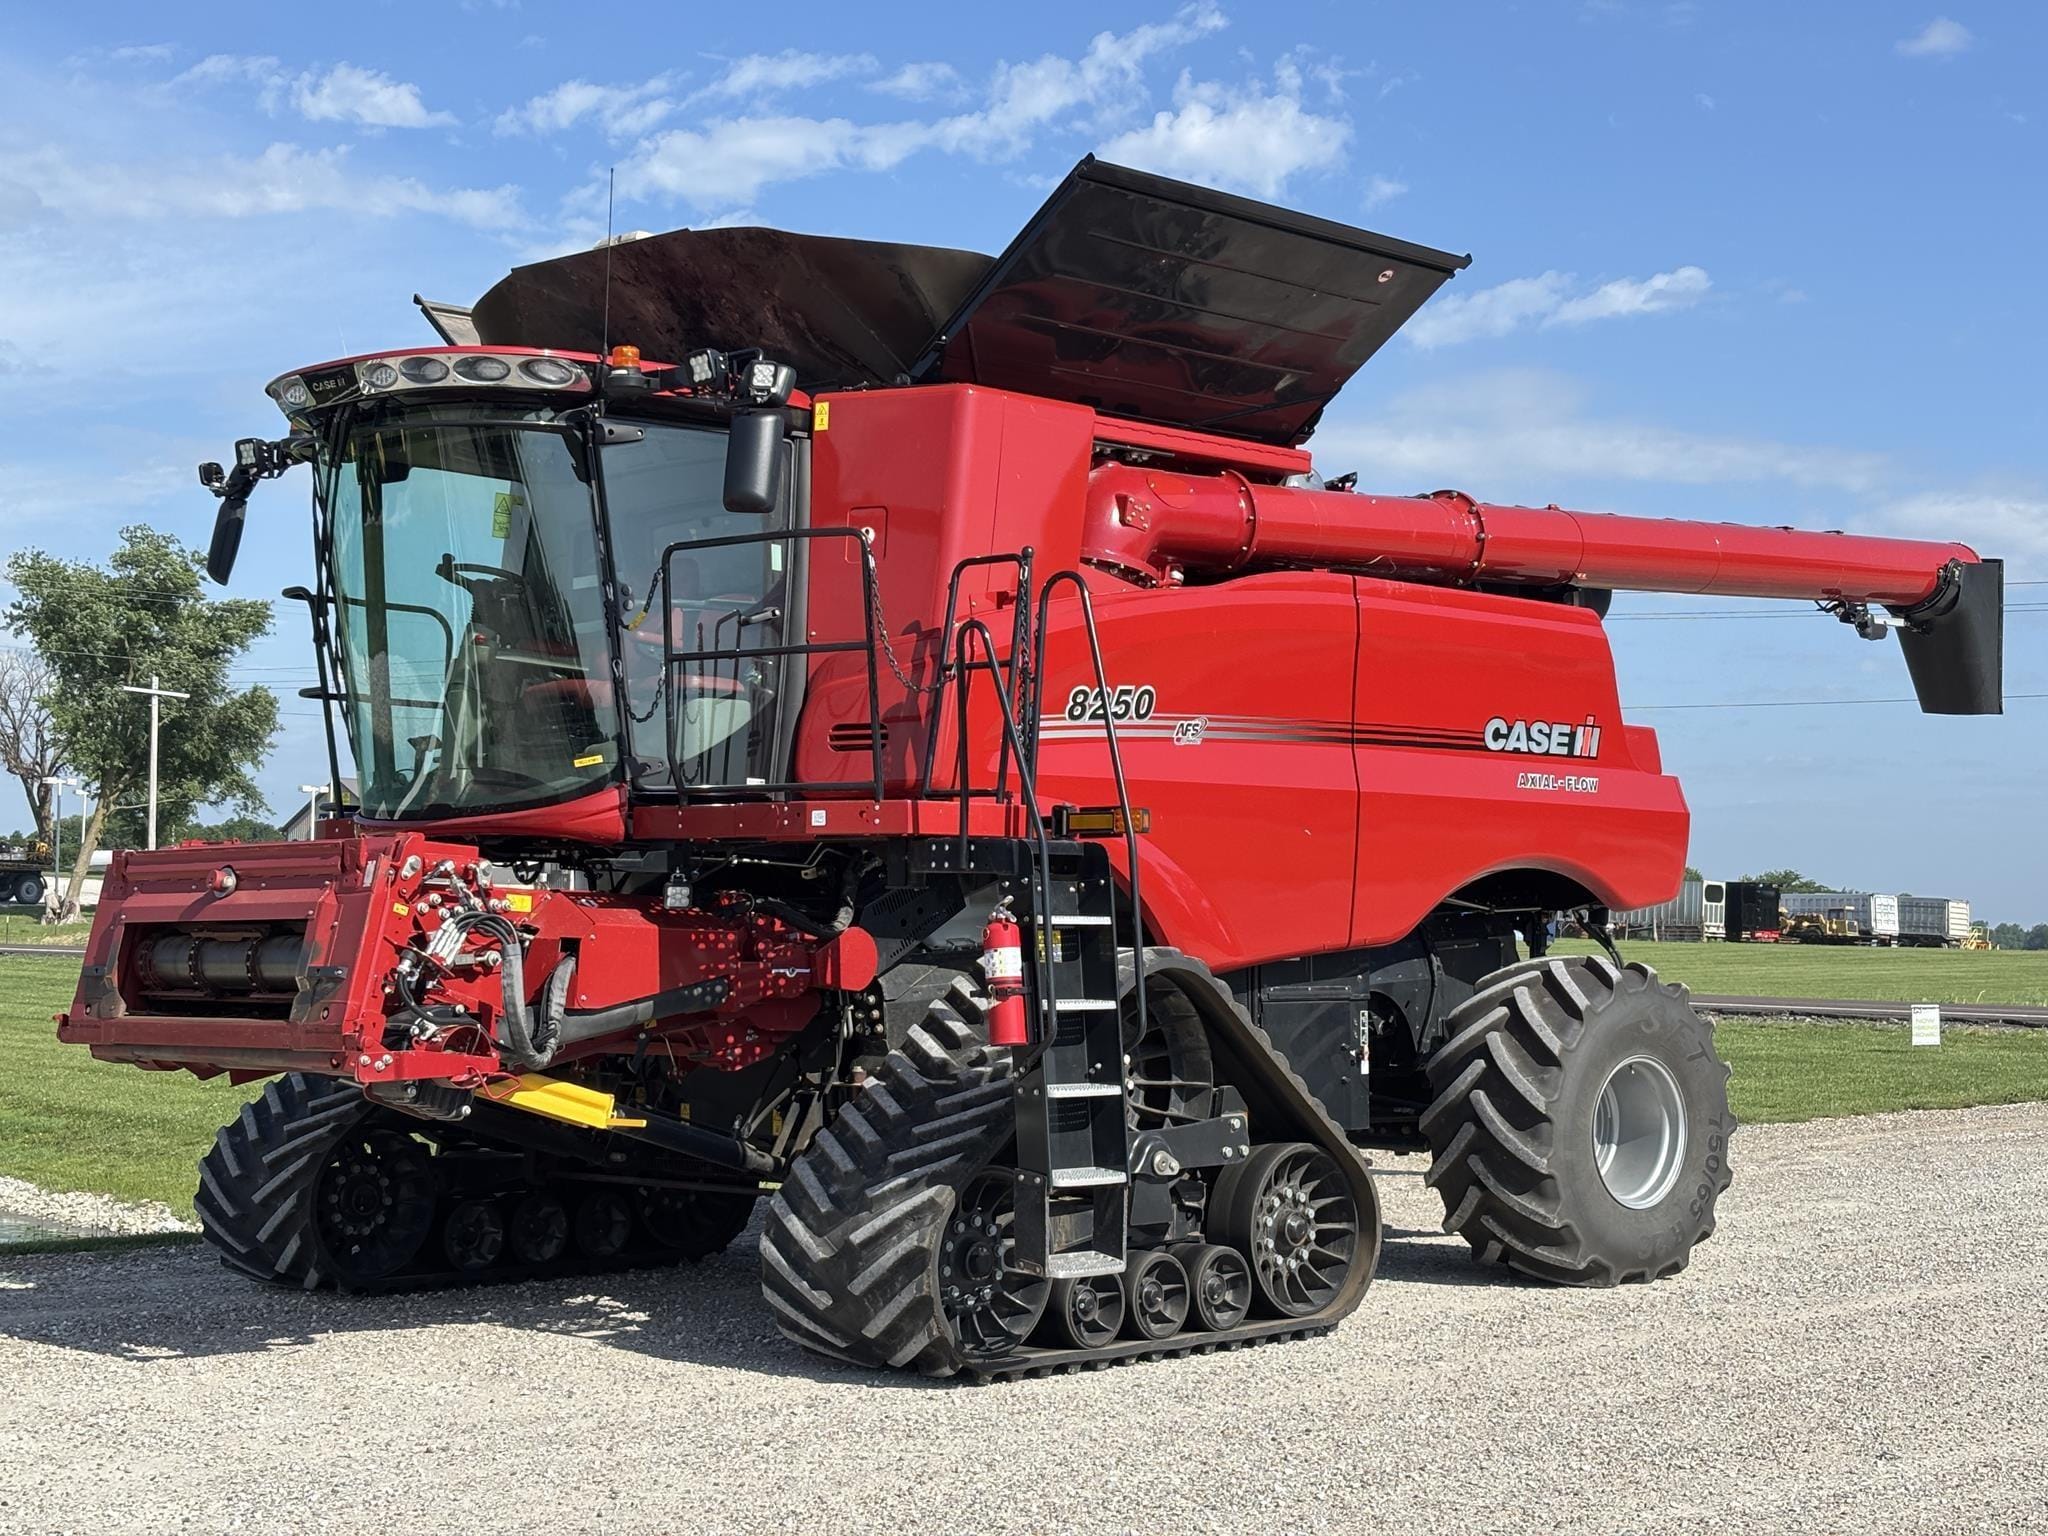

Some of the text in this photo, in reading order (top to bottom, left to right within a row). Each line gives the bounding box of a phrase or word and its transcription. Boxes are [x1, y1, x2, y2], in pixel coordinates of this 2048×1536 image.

[312, 379, 337, 392] CASE
[1065, 685, 1156, 722] 8250
[1175, 722, 1201, 737] AFS
[1484, 717, 1572, 756] CASE
[1517, 773, 1599, 793] AXIAL-FLOW
[1689, 1112, 1724, 1222] 750/65
